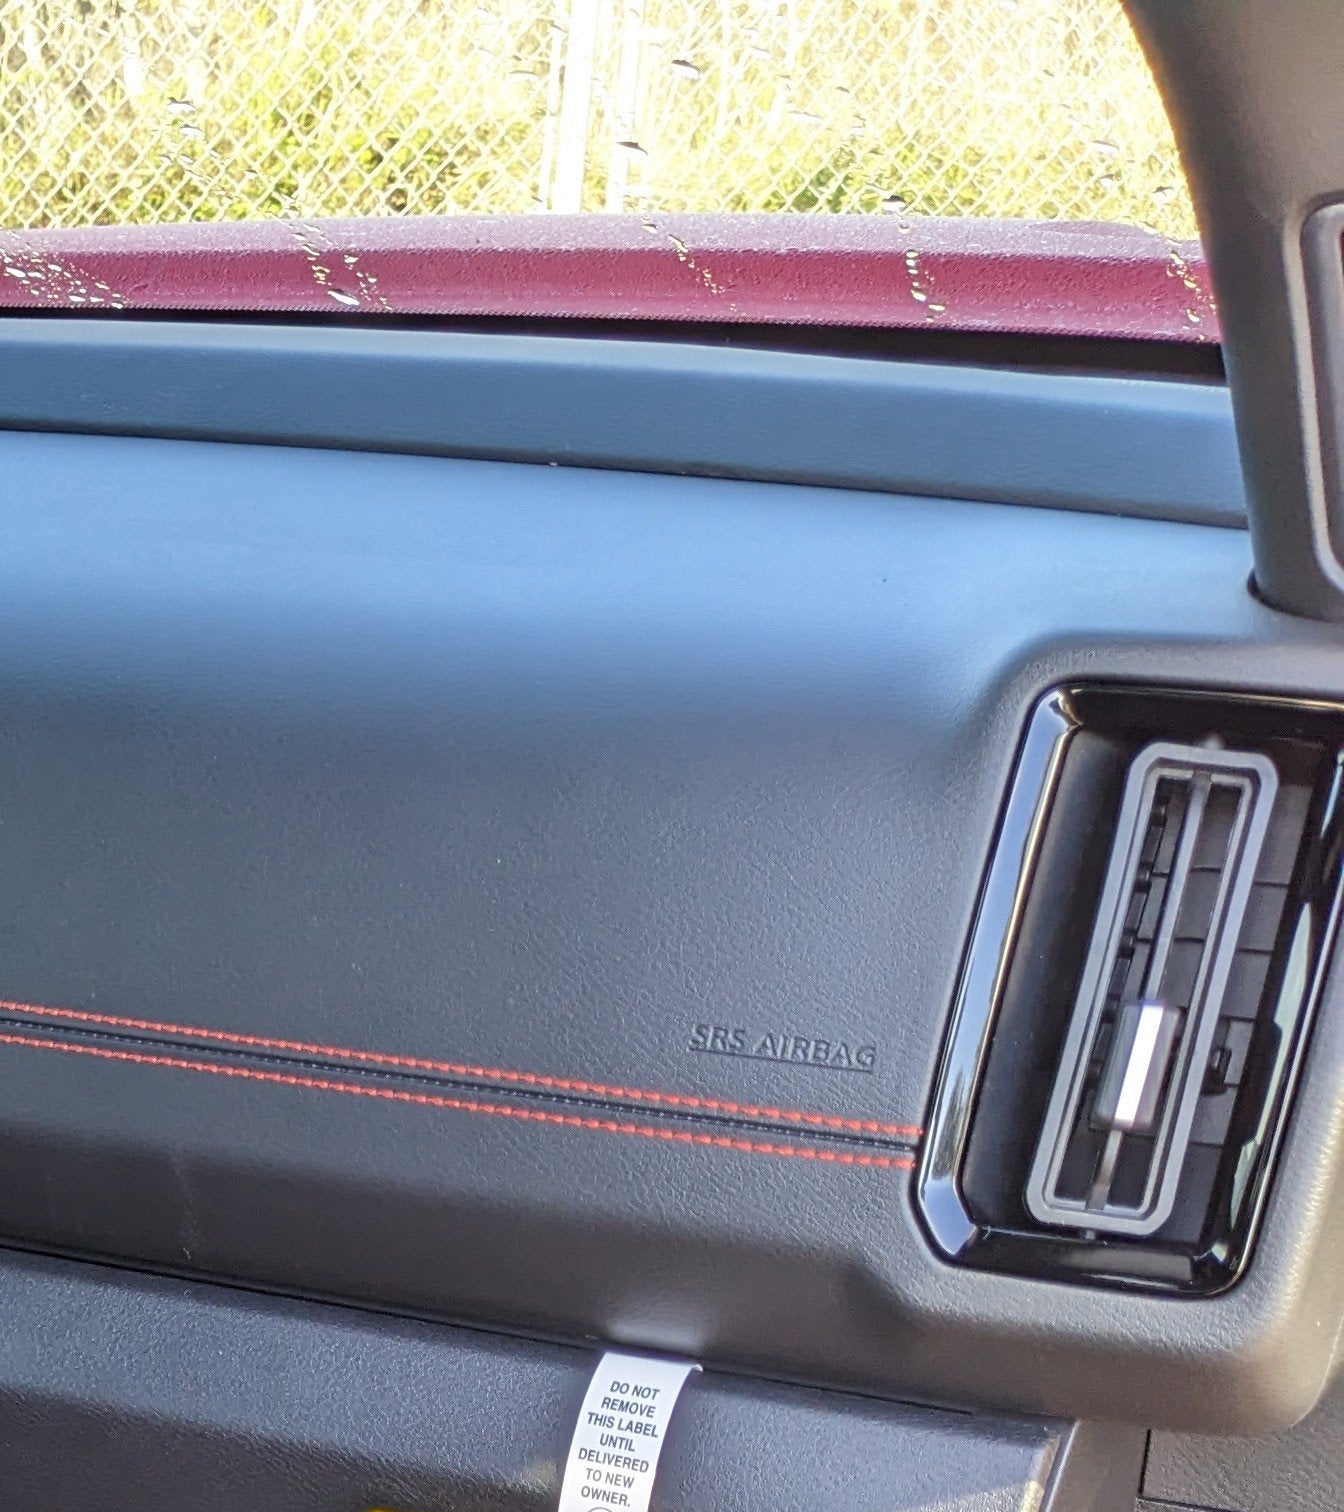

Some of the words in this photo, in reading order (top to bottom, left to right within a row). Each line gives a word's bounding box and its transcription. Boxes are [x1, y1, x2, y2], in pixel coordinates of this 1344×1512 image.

[687, 1023, 747, 1051] SRS
[751, 1031, 877, 1067] AIRBAG
[609, 1380, 630, 1393] DO
[631, 1385, 660, 1400] NOT
[600, 1396, 657, 1418] REMOVE
[587, 1411, 615, 1429] THIS
[617, 1418, 659, 1438] LABEL
[599, 1432, 636, 1452] UNTIL
[578, 1447, 650, 1473] DELIVERED
[586, 1468, 602, 1482] TO
[605, 1472, 636, 1489] NEW
[580, 1485, 631, 1508] OWNER.
